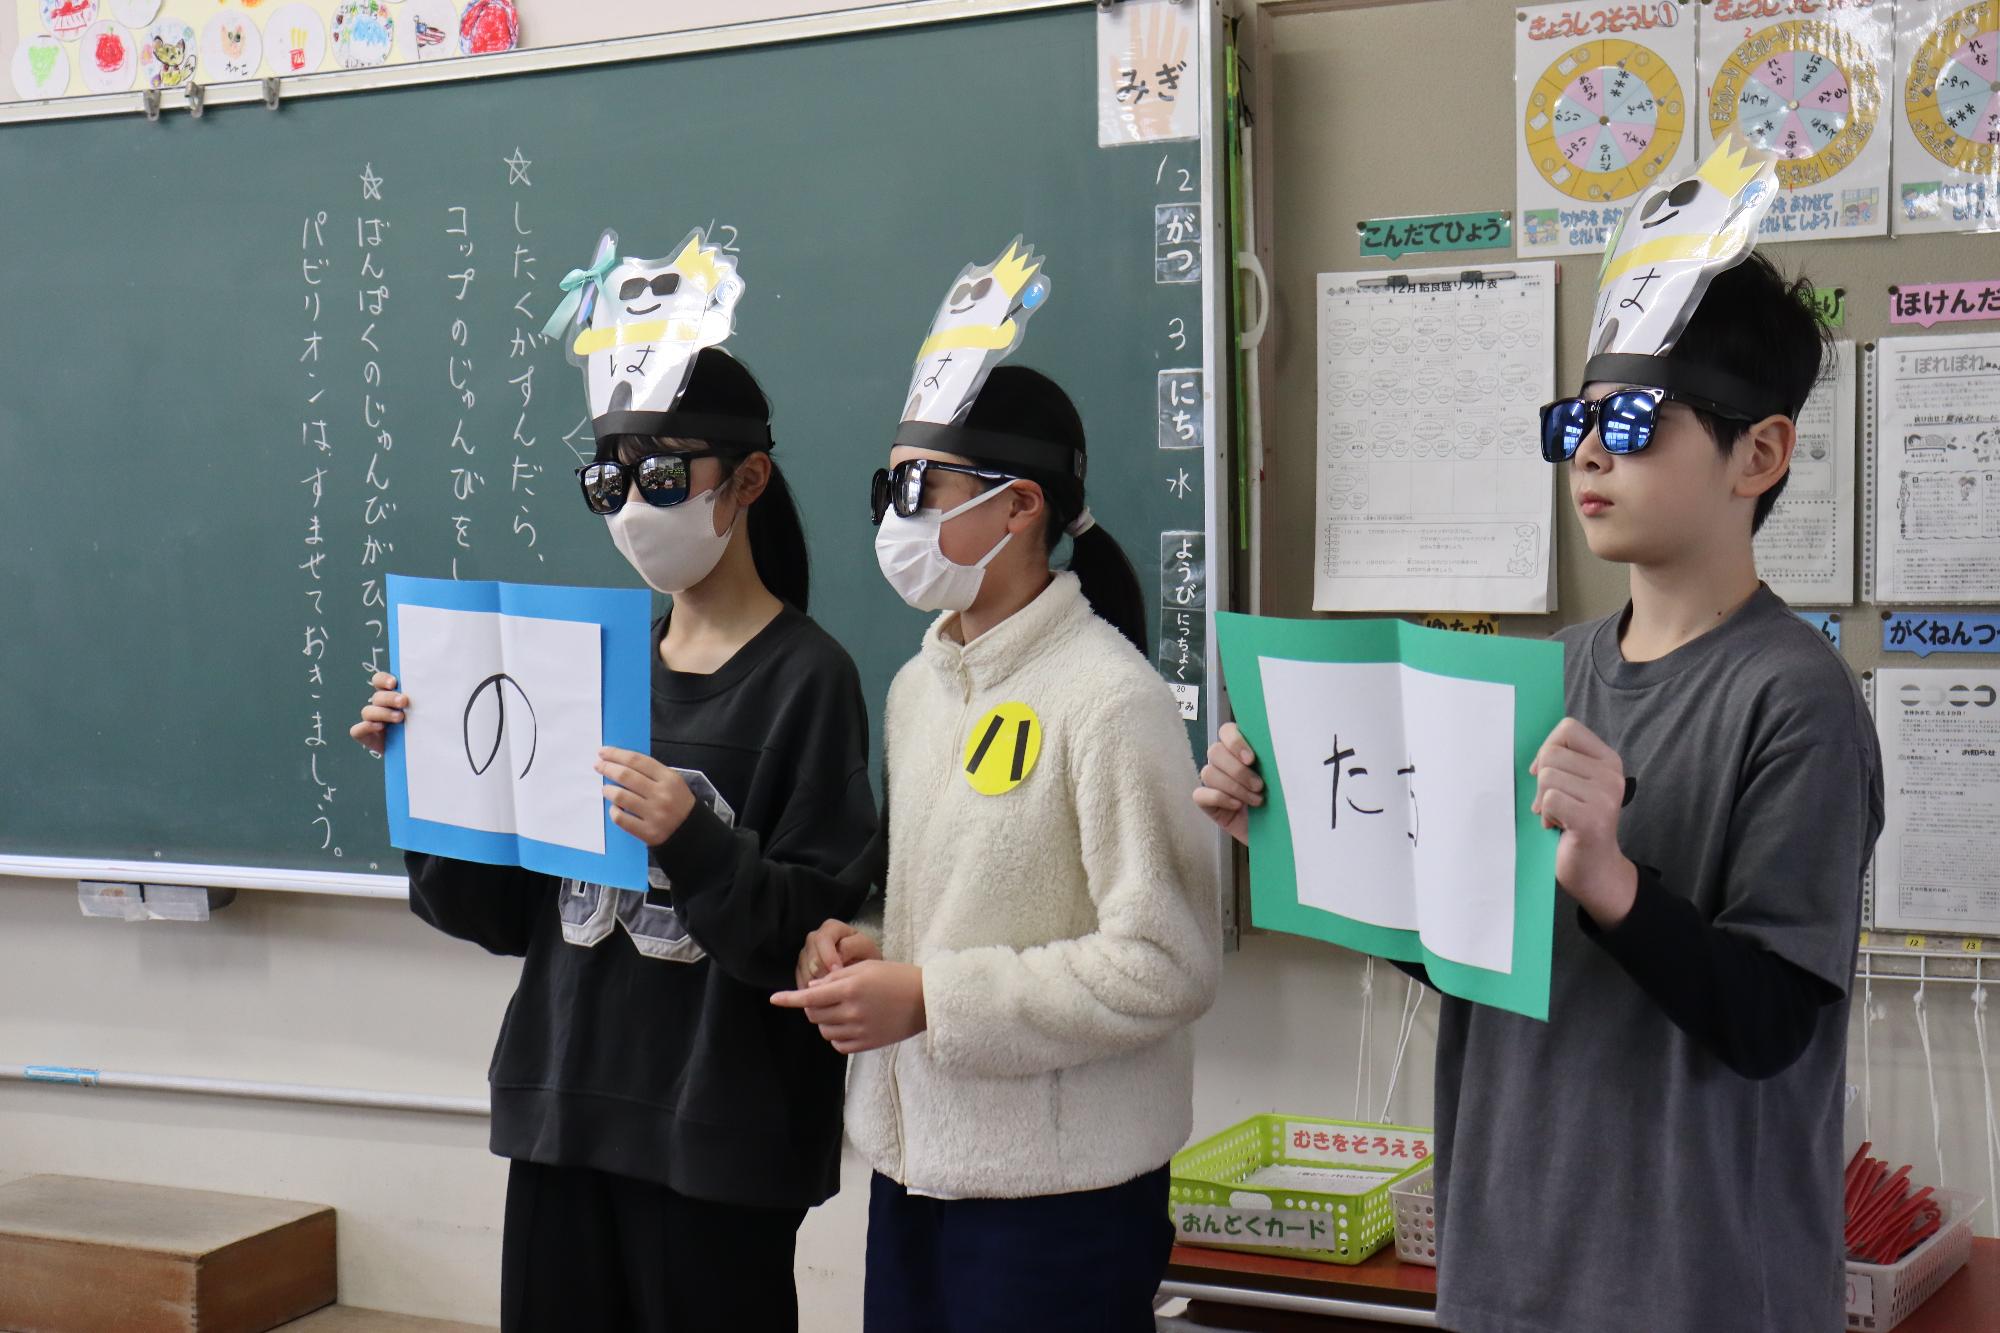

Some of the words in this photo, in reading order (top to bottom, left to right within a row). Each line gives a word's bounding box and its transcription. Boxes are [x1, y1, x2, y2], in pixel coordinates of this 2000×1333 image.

[1968, 39, 1988, 66] れな
[1116, 60, 1187, 104] みぎ
[1767, 58, 1786, 85] れいか
[1156, 154, 1193, 192] 12
[1166, 213, 1196, 272] がつ
[1363, 218, 1501, 248] こんだてひょう
[1167, 317, 1186, 351] 3
[609, 344, 656, 378] は
[1914, 353, 1985, 375] ぽれぽれ
[1170, 380, 1195, 441] にち
[1166, 467, 1192, 500] 水
[1175, 538, 1196, 605] ようび
[1176, 611, 1190, 680] にっちょく
[1890, 619, 2000, 645] がくねんつ
[463, 673, 538, 779] の
[1909, 938, 1919, 947] 12
[1293, 1130, 1429, 1160] むきをそろえる
